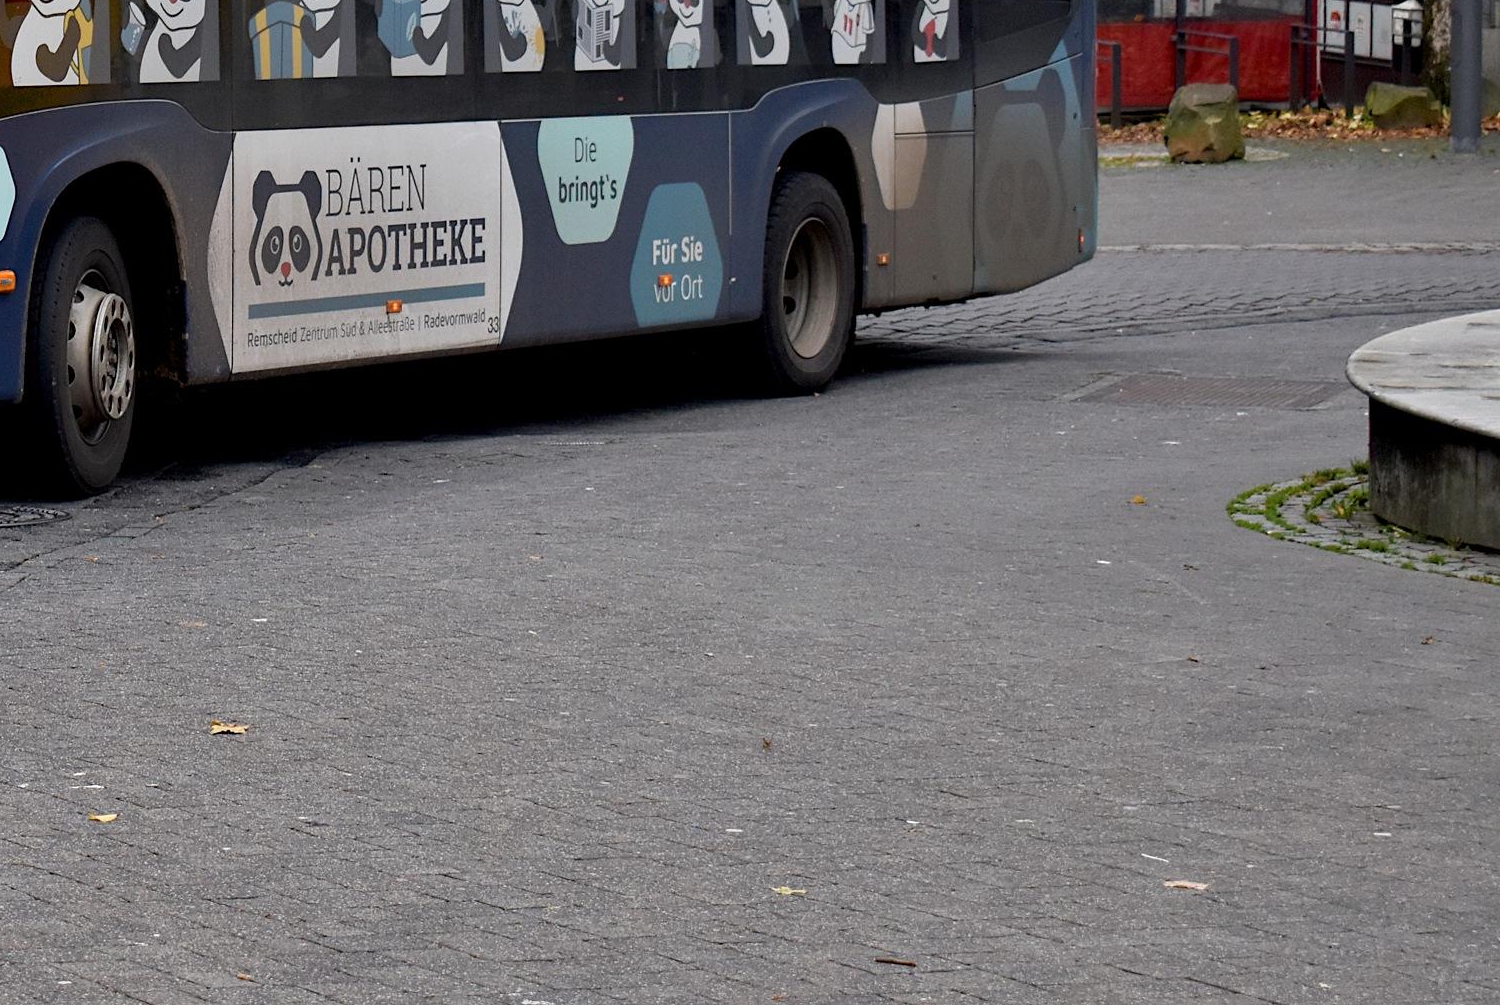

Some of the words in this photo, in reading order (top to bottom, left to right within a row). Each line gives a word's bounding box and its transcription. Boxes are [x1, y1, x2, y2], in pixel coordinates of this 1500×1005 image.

[574, 136, 597, 163] Die
[325, 157, 427, 217] BÄREN
[558, 174, 617, 209] bringt's
[325, 217, 486, 277] APOTHEKE
[652, 238, 678, 266] Für
[681, 236, 703, 263] Sie
[653, 280, 676, 303] vor
[681, 274, 703, 301] Ort
[247, 326, 298, 347] Remscheid
[300, 324, 339, 342] Zentrum
[340, 321, 357, 338] Süd
[359, 321, 365, 336] &
[368, 316, 415, 335] Alleestraße
[424, 308, 486, 329] Radevormwald
[487, 316, 500, 334] 33
